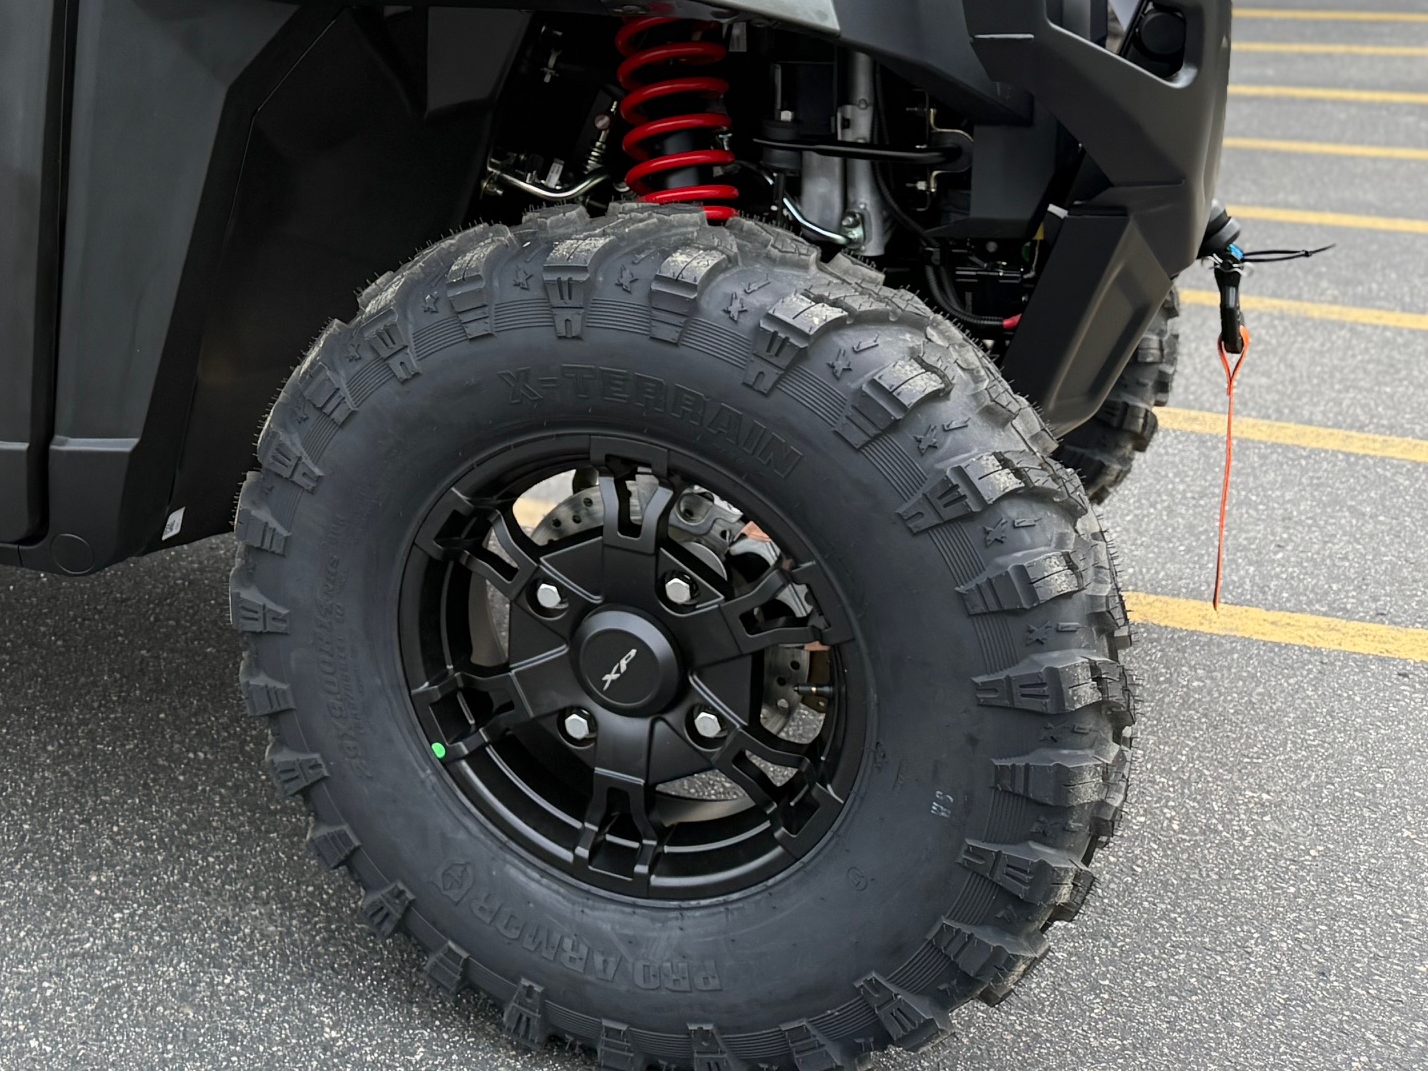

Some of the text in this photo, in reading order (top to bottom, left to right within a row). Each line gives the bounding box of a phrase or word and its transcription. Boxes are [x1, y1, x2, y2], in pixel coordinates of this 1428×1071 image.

[497, 363, 803, 479] X-TERRAIN
[601, 648, 637, 692] XP
[471, 892, 723, 993] PRO ARMOR
